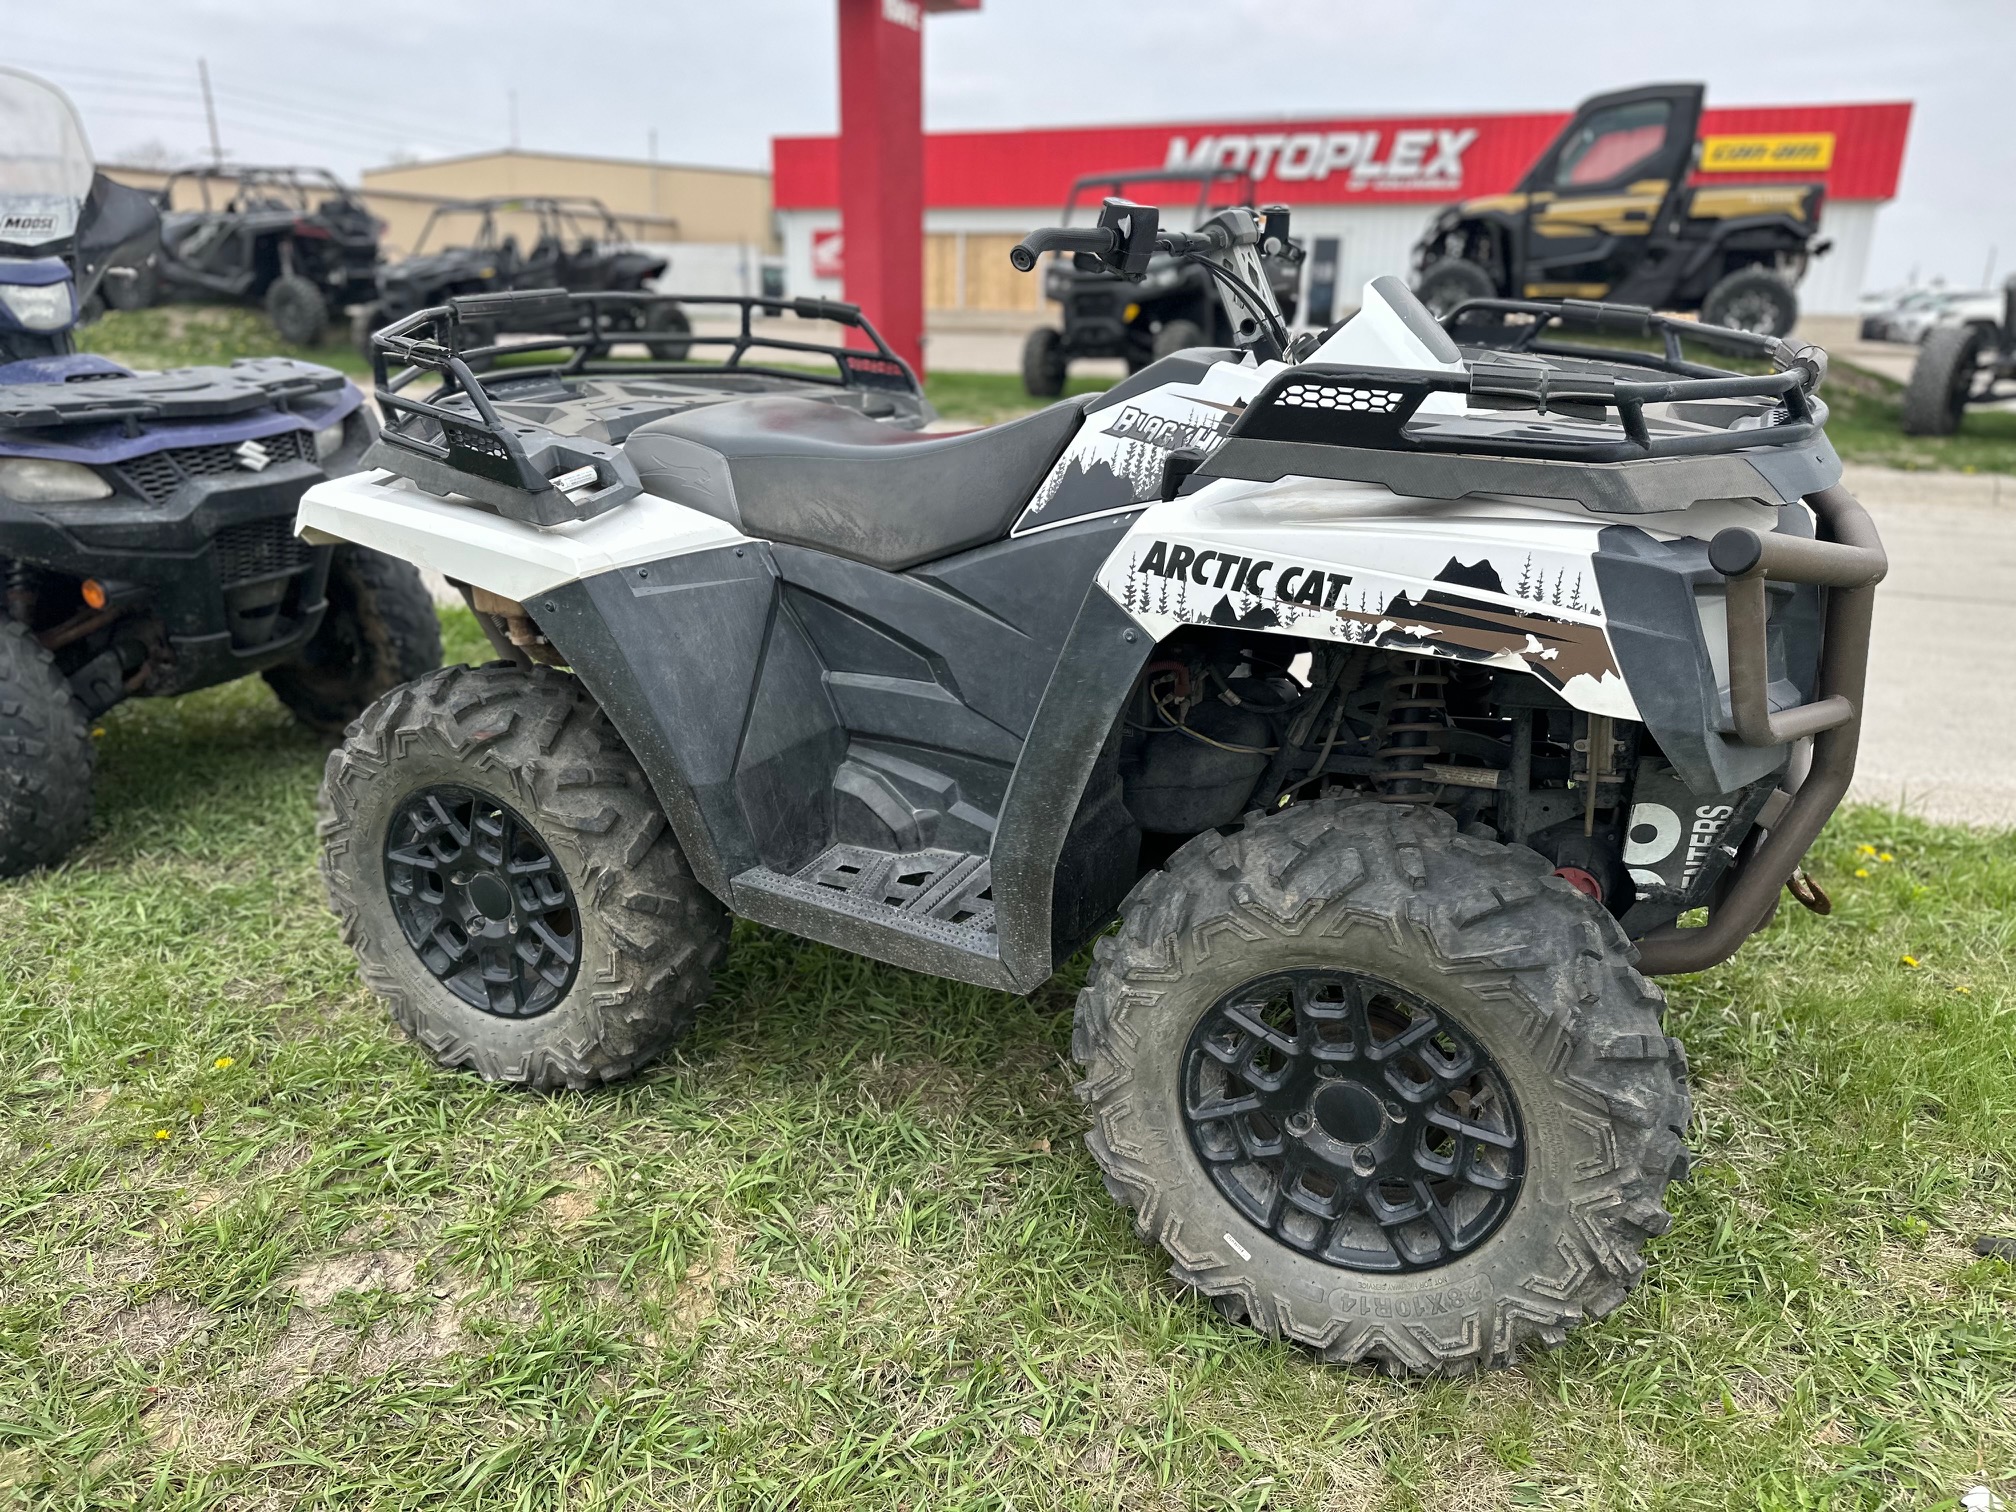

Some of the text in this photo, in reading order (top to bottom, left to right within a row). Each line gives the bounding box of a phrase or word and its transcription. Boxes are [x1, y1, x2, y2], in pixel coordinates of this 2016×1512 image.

[1164, 129, 1477, 181] MOTOPLEX
[1137, 540, 1353, 609] ARCTIC CAT
[1340, 1280, 1483, 1319] 28X10R14
